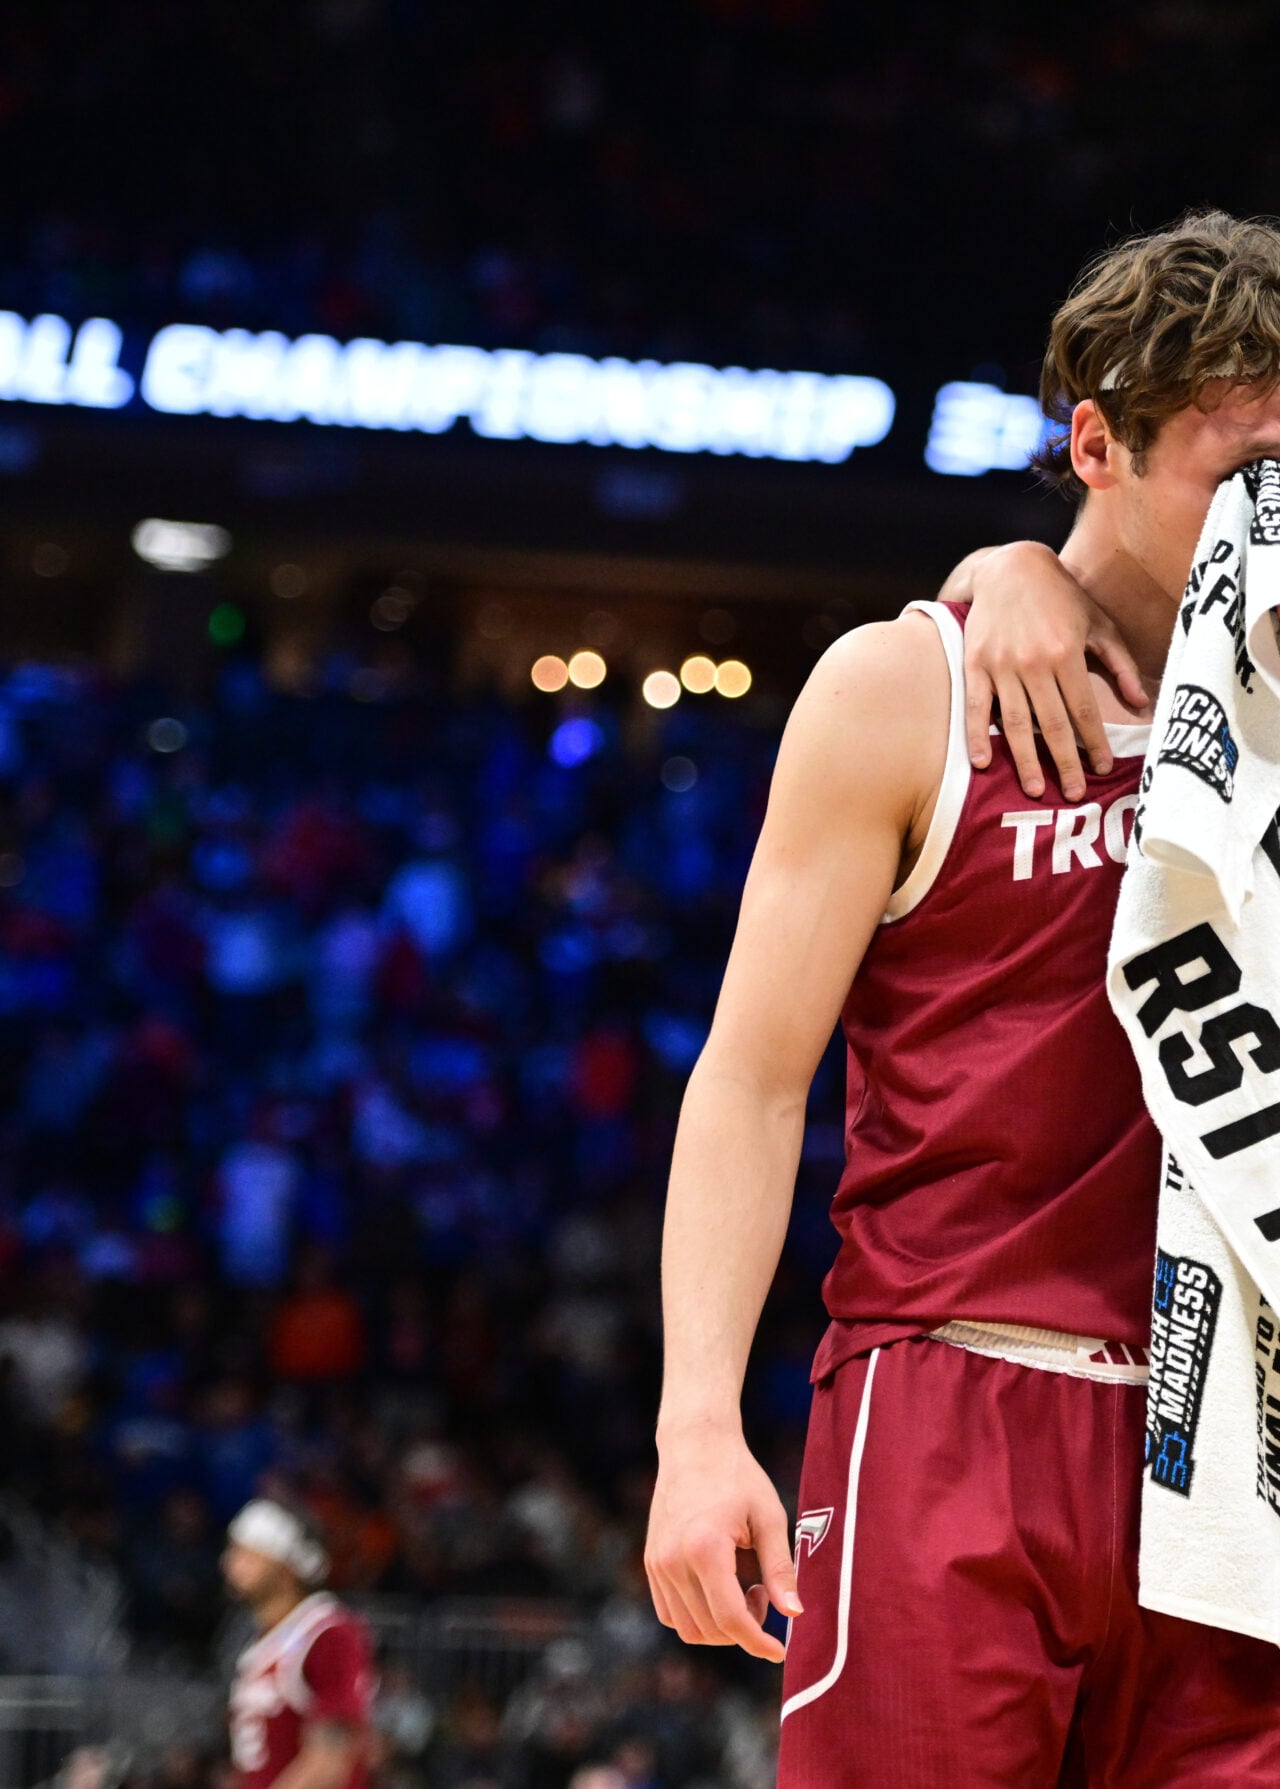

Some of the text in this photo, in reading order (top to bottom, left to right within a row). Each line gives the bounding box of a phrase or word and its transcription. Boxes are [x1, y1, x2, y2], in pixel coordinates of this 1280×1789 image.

[140, 323, 896, 464] CHAMPIONSHIP
[1158, 1260, 1209, 1425] MADNESS
[1256, 1315, 1275, 1357] TO
